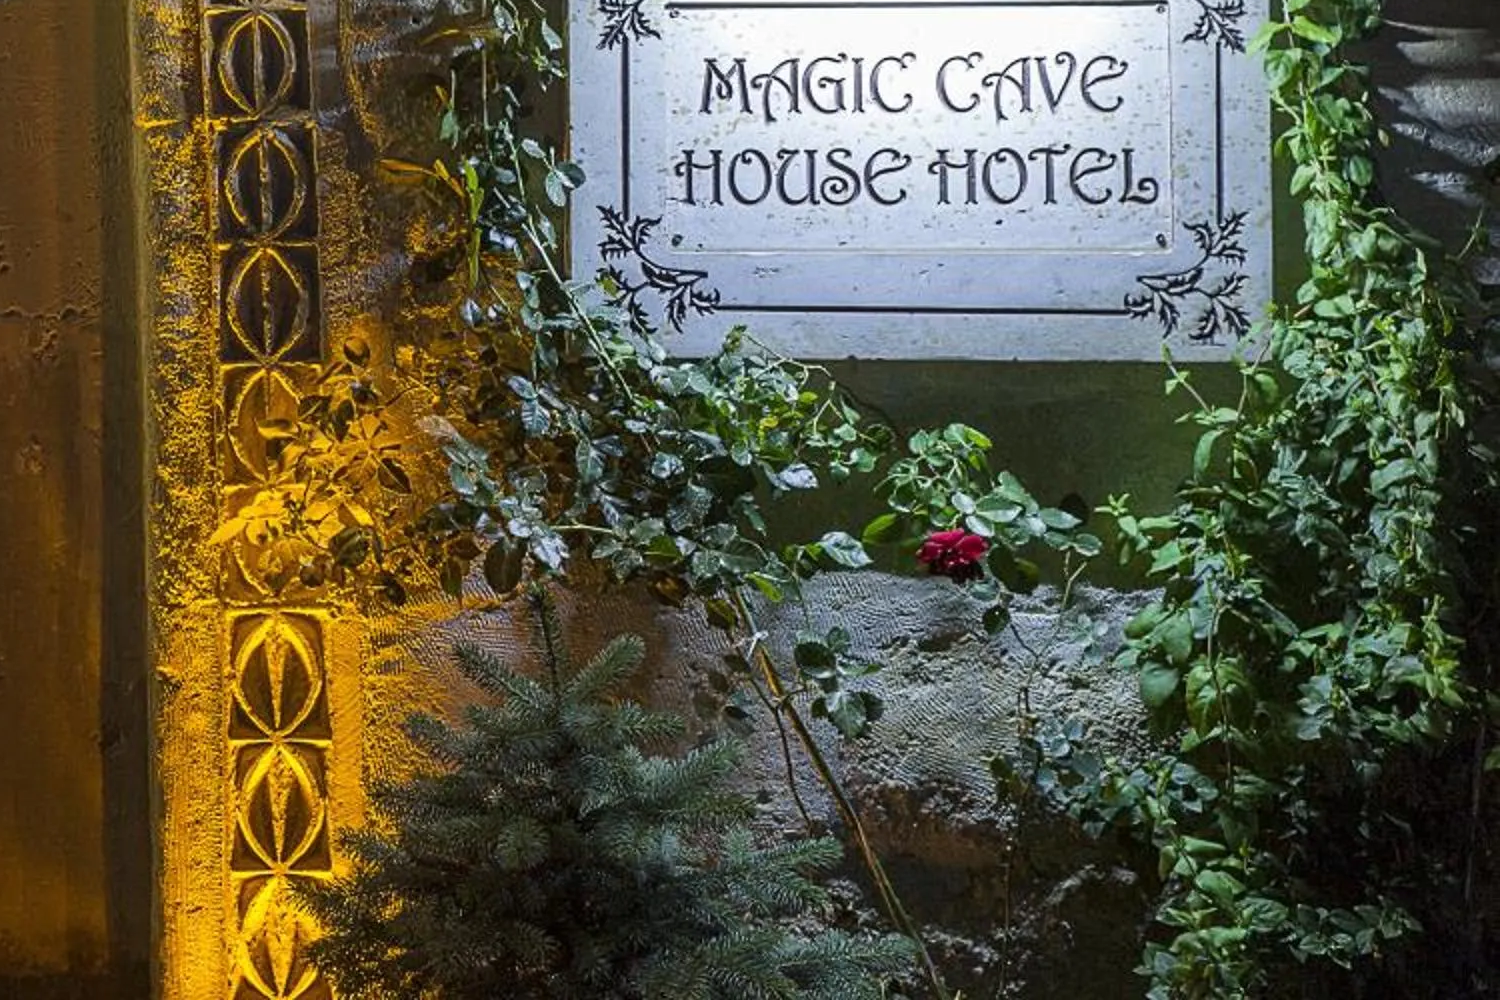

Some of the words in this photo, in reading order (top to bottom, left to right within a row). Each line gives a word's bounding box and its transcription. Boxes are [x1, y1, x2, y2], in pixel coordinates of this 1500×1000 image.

[698, 51, 917, 124] MAGIC
[935, 51, 1129, 125] CAVE
[674, 147, 913, 206] HOUSE
[927, 143, 1160, 206] HOTEL
